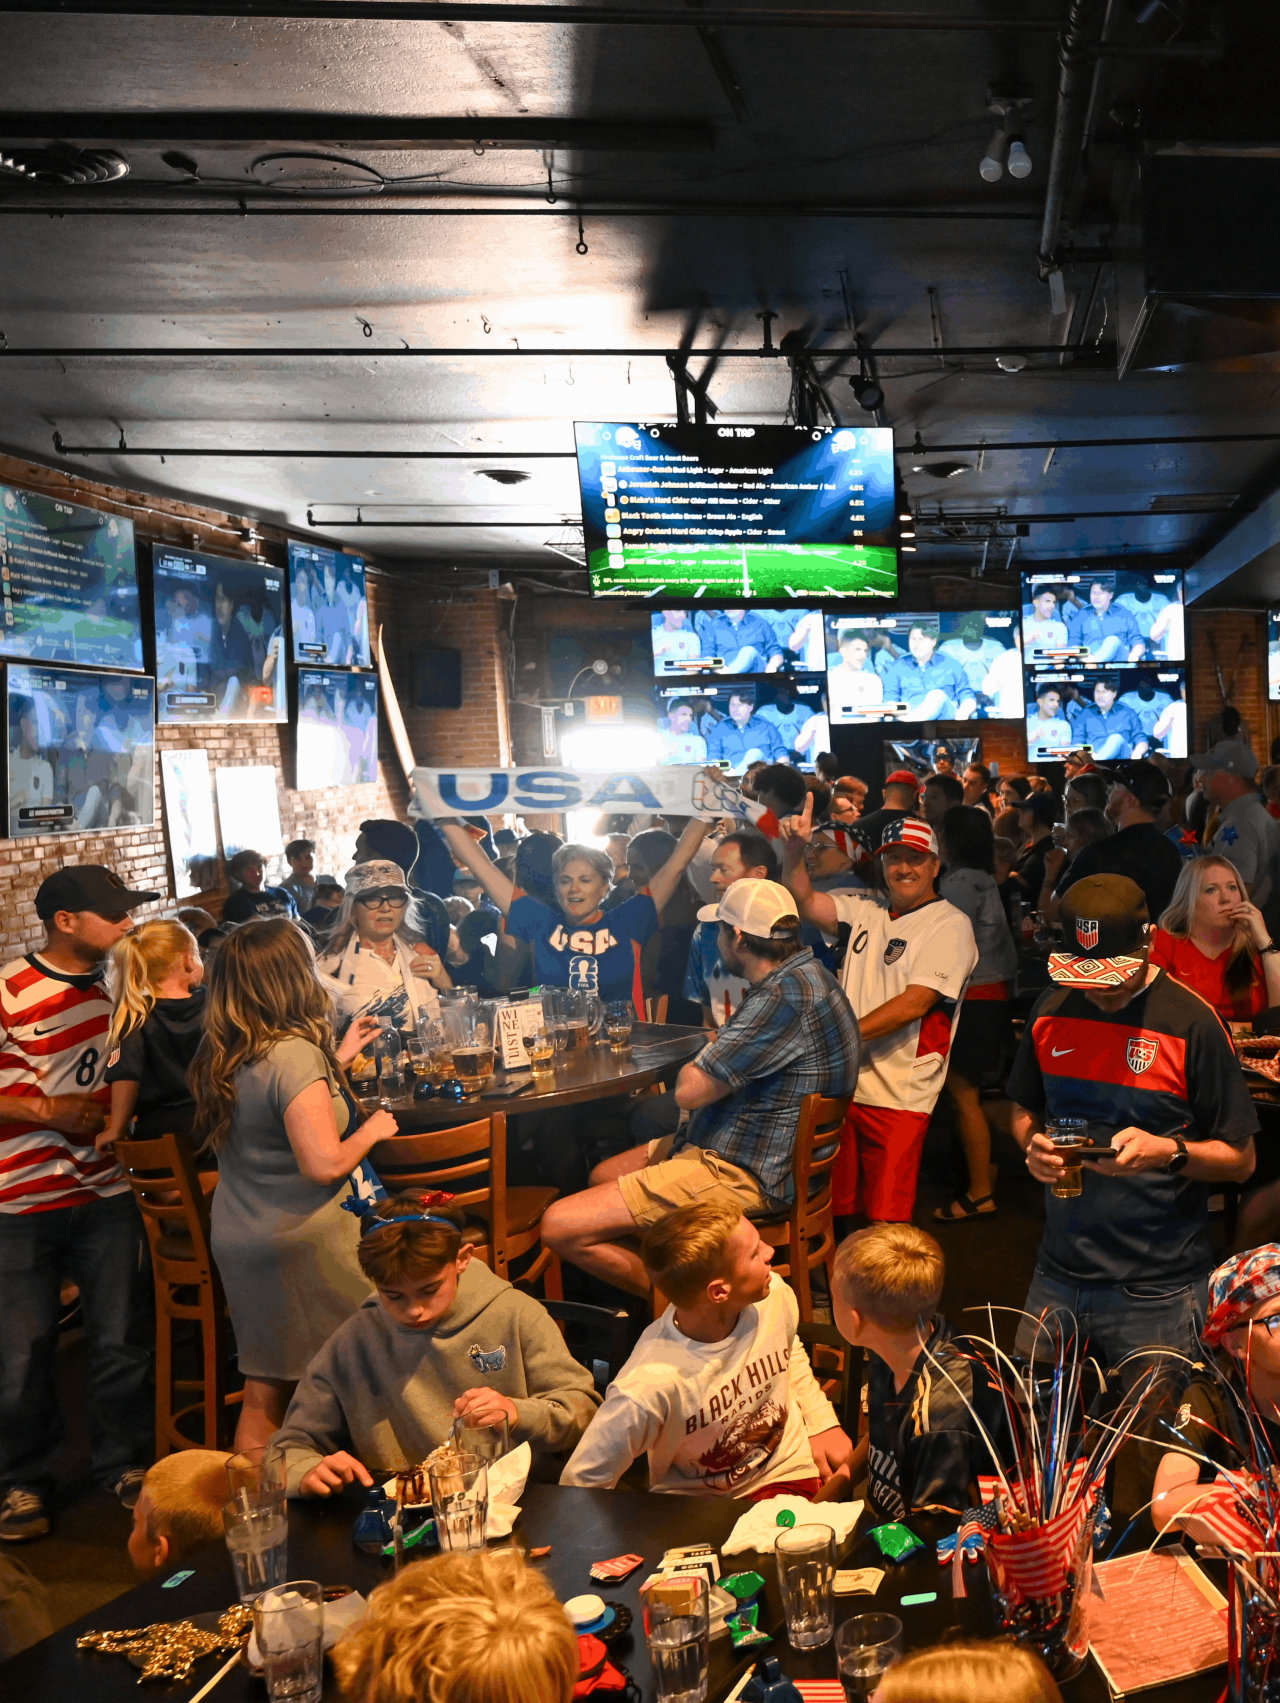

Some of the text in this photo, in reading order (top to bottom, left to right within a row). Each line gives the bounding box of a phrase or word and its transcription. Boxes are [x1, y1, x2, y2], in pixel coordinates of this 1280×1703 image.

[717, 427, 755, 438] ON TAP
[687, 466, 704, 475] Light
[707, 467, 724, 475] Lager
[758, 467, 774, 475] Light
[629, 496, 654, 504] Blake's
[55, 503, 63, 513] ON
[741, 513, 763, 521] English
[623, 528, 644, 536] Angry
[707, 528, 724, 536] Crisp
[438, 771, 664, 811] USA
[1077, 917, 1098, 934] USA
[549, 924, 619, 955] USA
[934, 971, 949, 982] USA
[506, 1032, 520, 1059] LIST
[76, 1047, 99, 1086] 8
[686, 1348, 790, 1435] BLACK HILLS
[721, 1382, 772, 1425] RAPIDS
